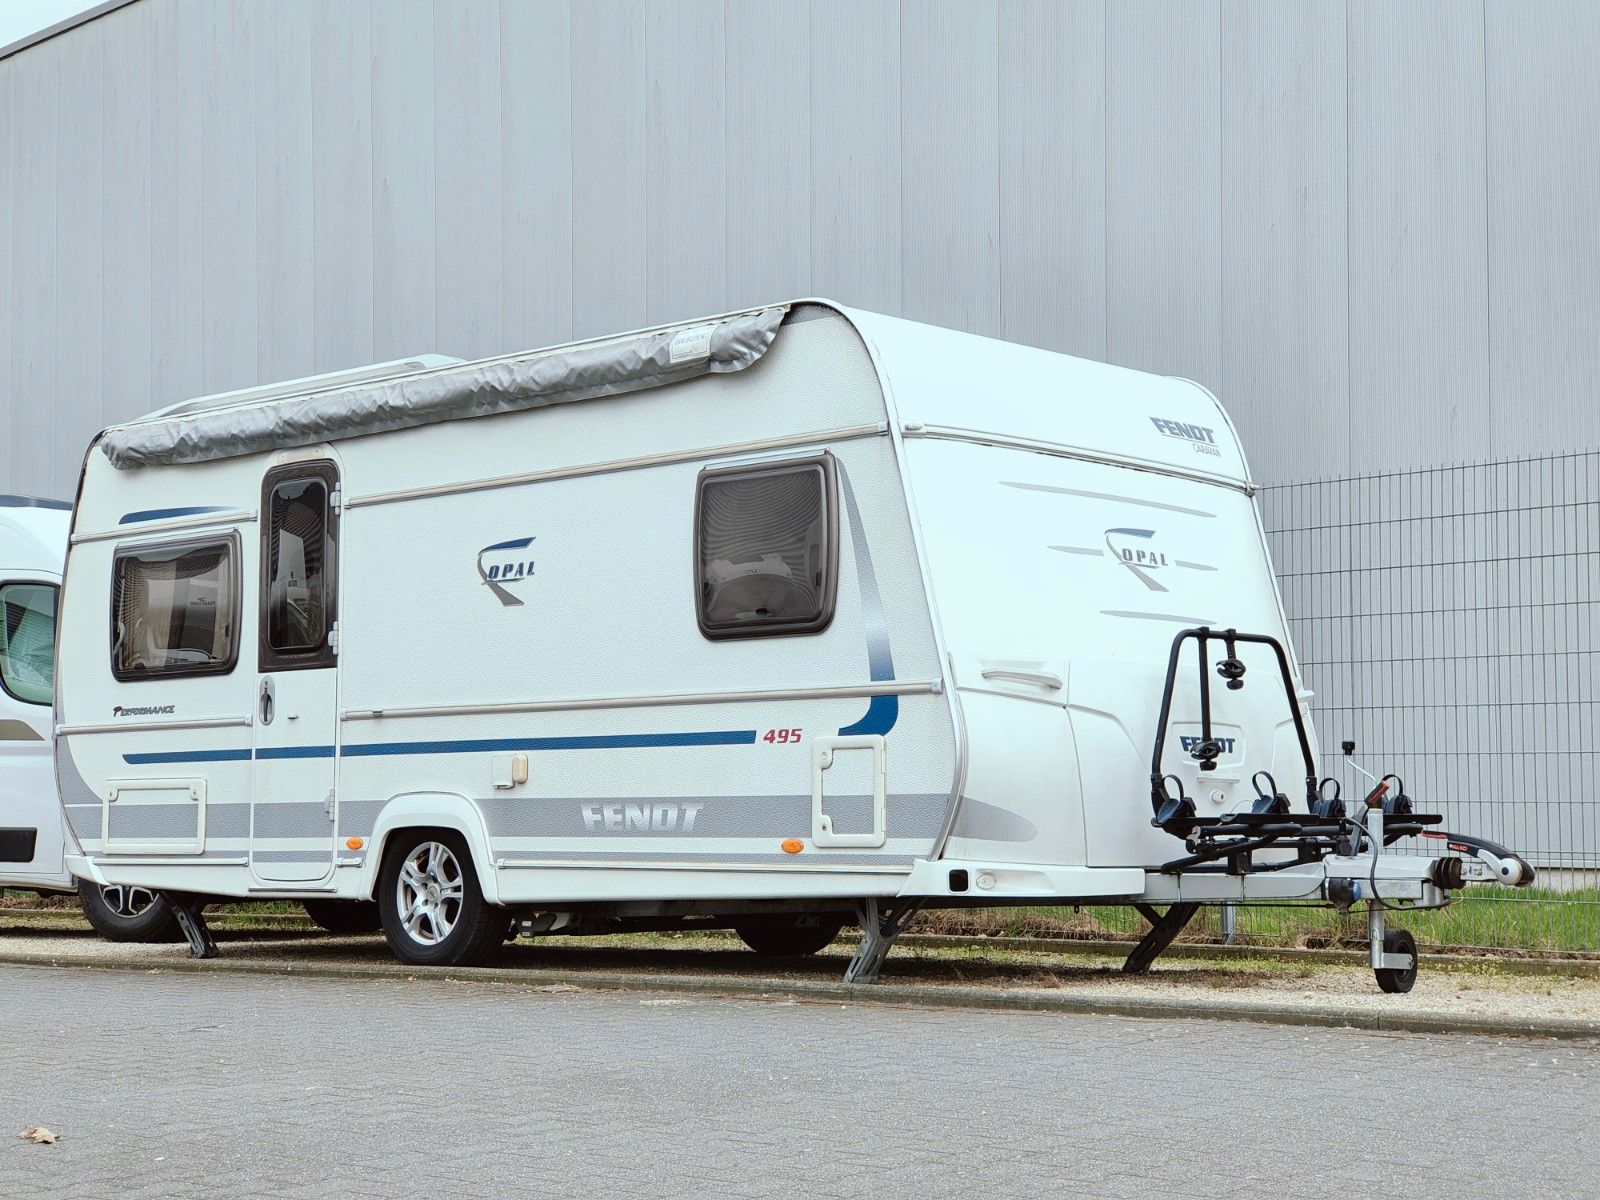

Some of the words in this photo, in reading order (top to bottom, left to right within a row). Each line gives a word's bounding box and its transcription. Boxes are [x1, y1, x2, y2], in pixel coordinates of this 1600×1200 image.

[1149, 416, 1215, 444] FENDT
[1122, 548, 1168, 567] OPAL
[488, 561, 535, 579] OPAL
[113, 705, 175, 717] PERFORMANCE
[763, 728, 803, 744] 495
[1180, 736, 1236, 753] FEDT
[580, 804, 704, 832] FENDT
